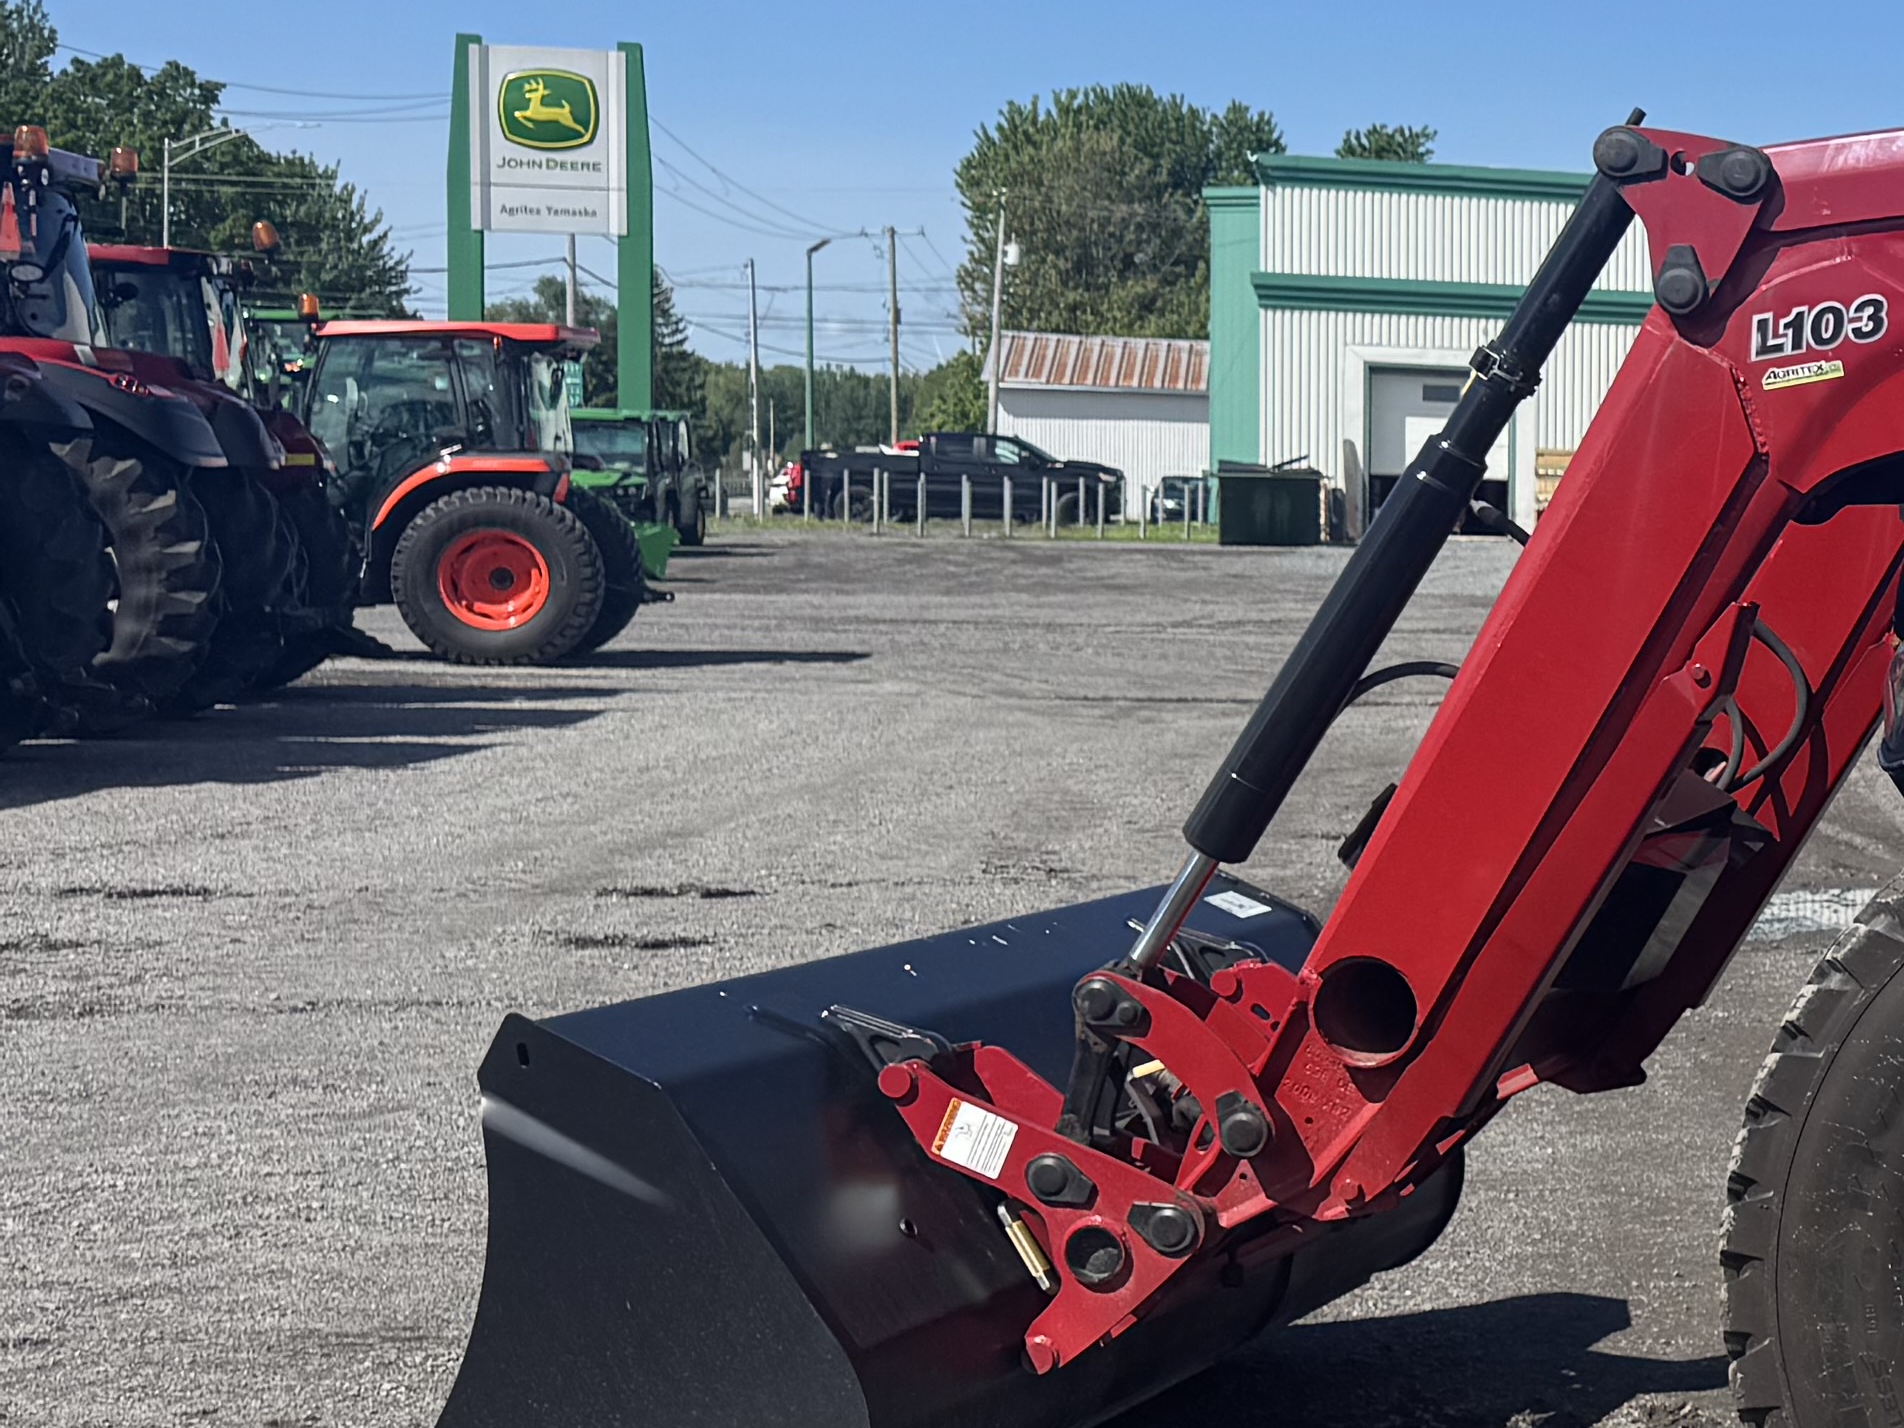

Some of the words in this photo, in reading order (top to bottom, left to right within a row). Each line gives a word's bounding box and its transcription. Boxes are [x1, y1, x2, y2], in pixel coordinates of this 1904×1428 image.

[496, 156, 543, 170] JOHN
[545, 157, 602, 172] DEERE
[1750, 293, 1888, 362] L103
